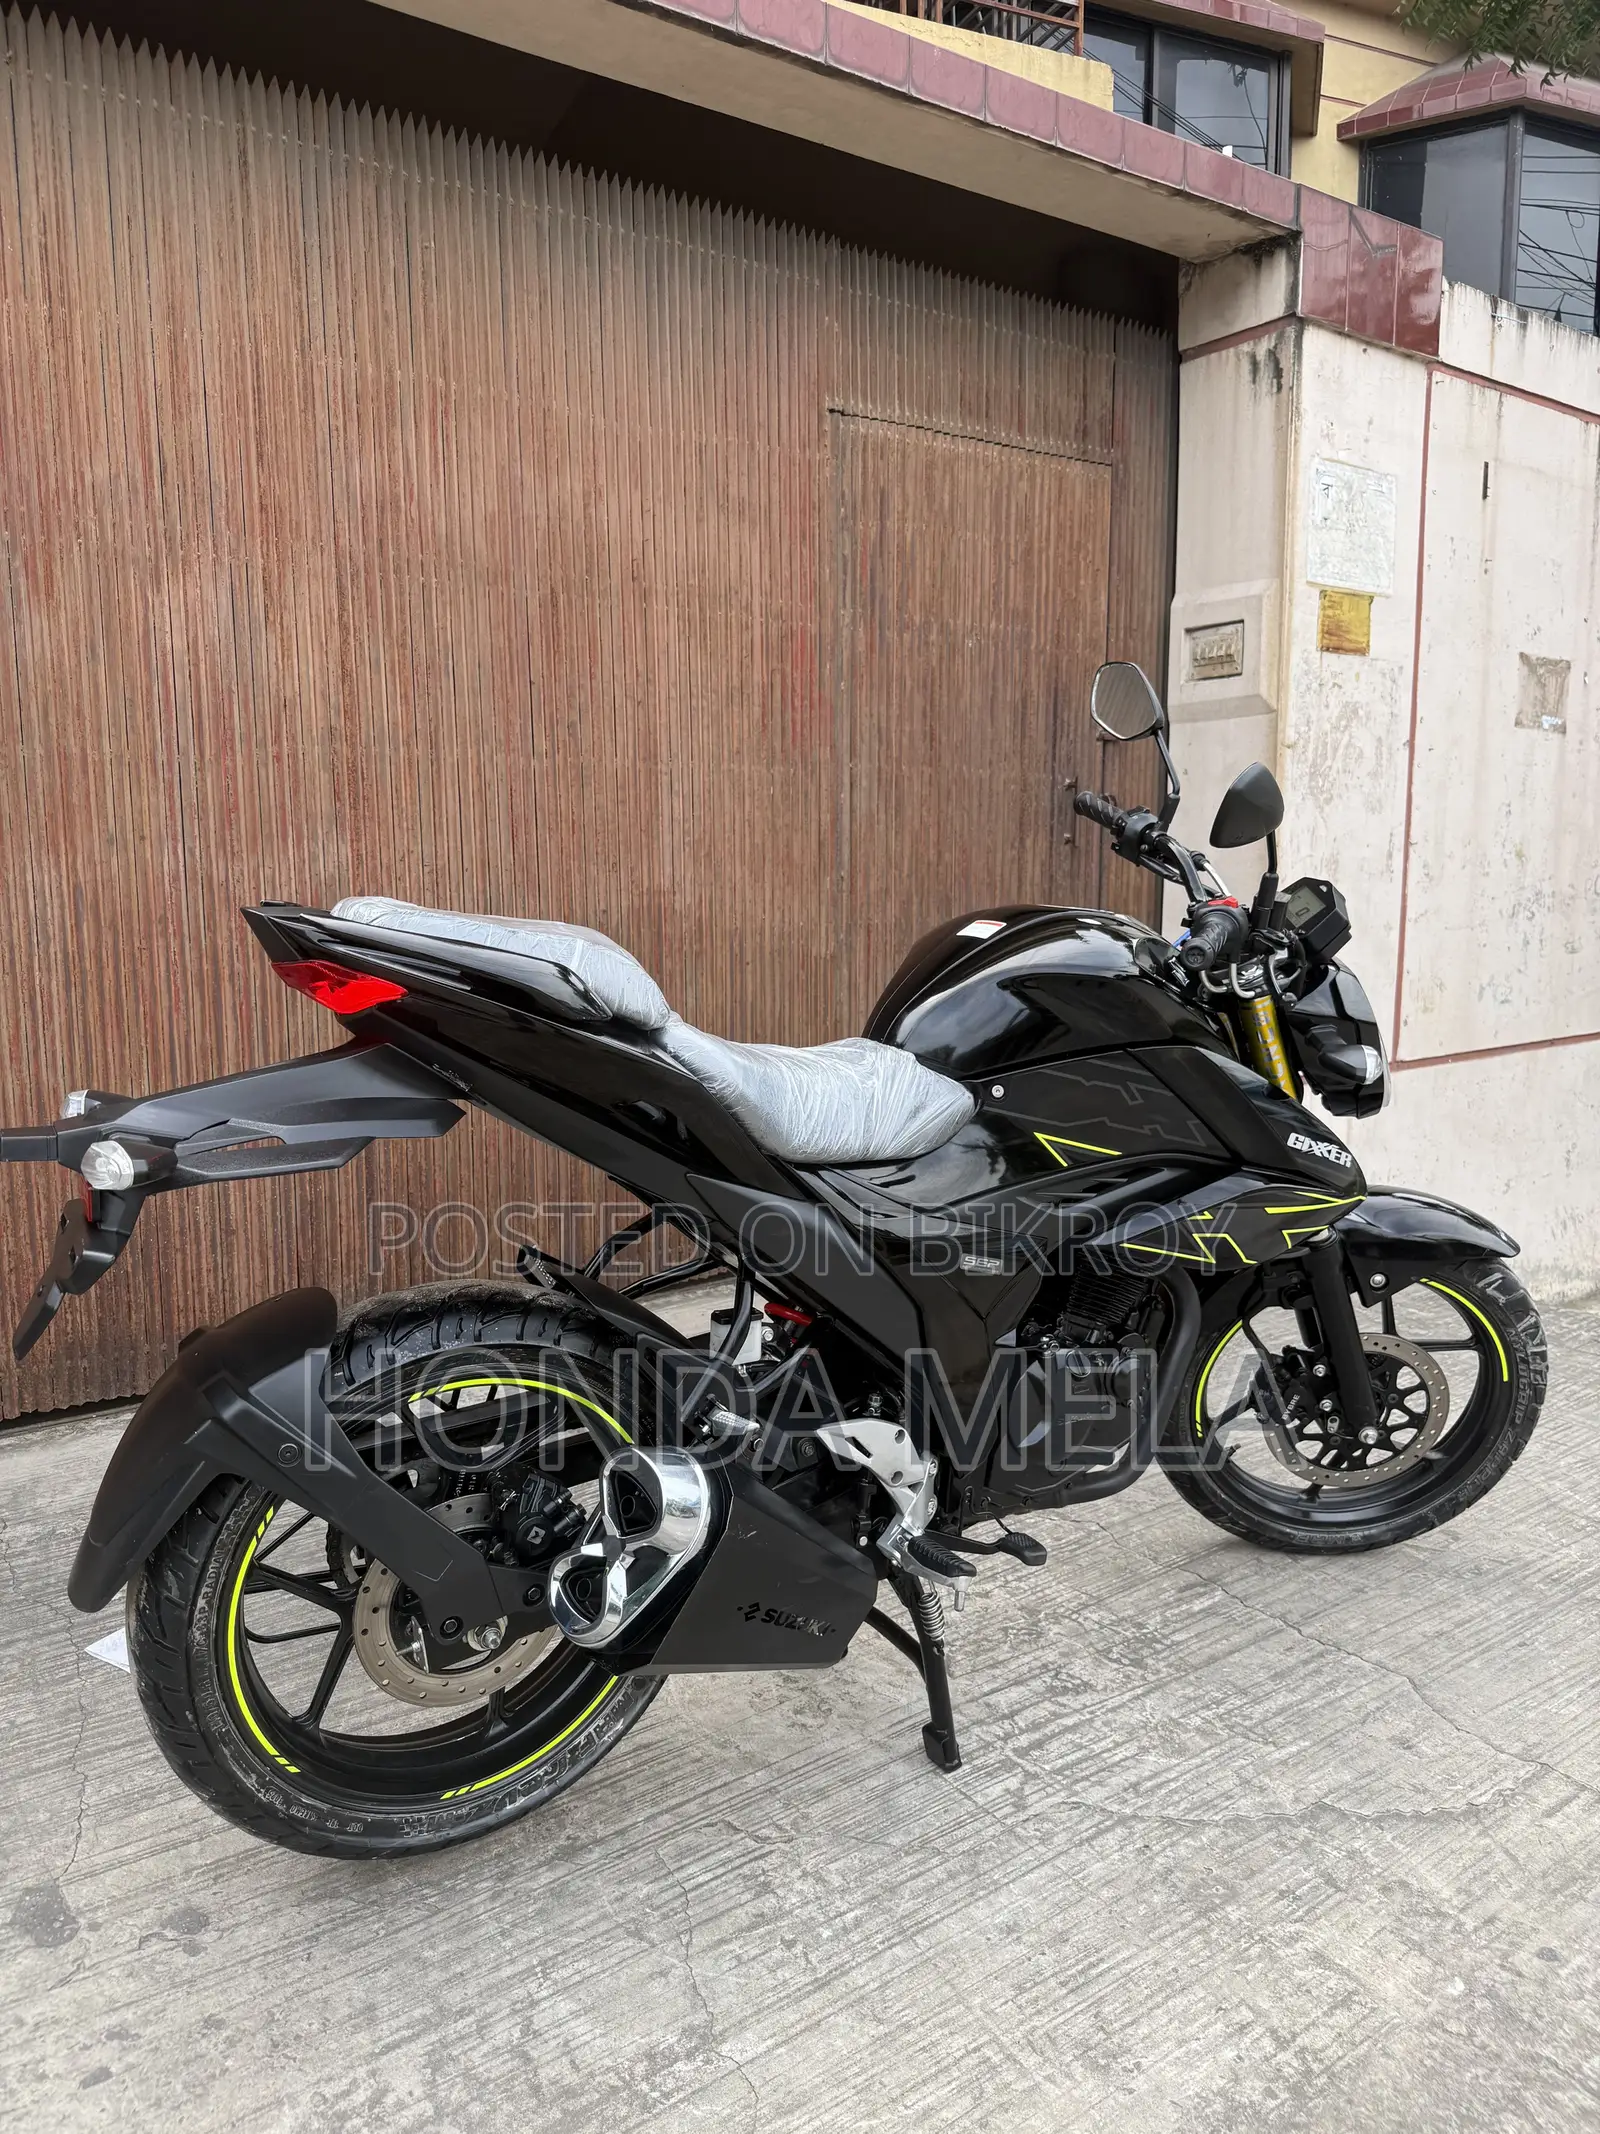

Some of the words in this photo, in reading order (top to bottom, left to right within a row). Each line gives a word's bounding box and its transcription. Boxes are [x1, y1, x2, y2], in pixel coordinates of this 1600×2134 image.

[1286, 1132, 1353, 1168] GIXXER
[963, 1256, 1000, 1268] SEP
[1281, 1394, 1301, 1420] BYBRE
[760, 1608, 832, 1637] SUZUKI
